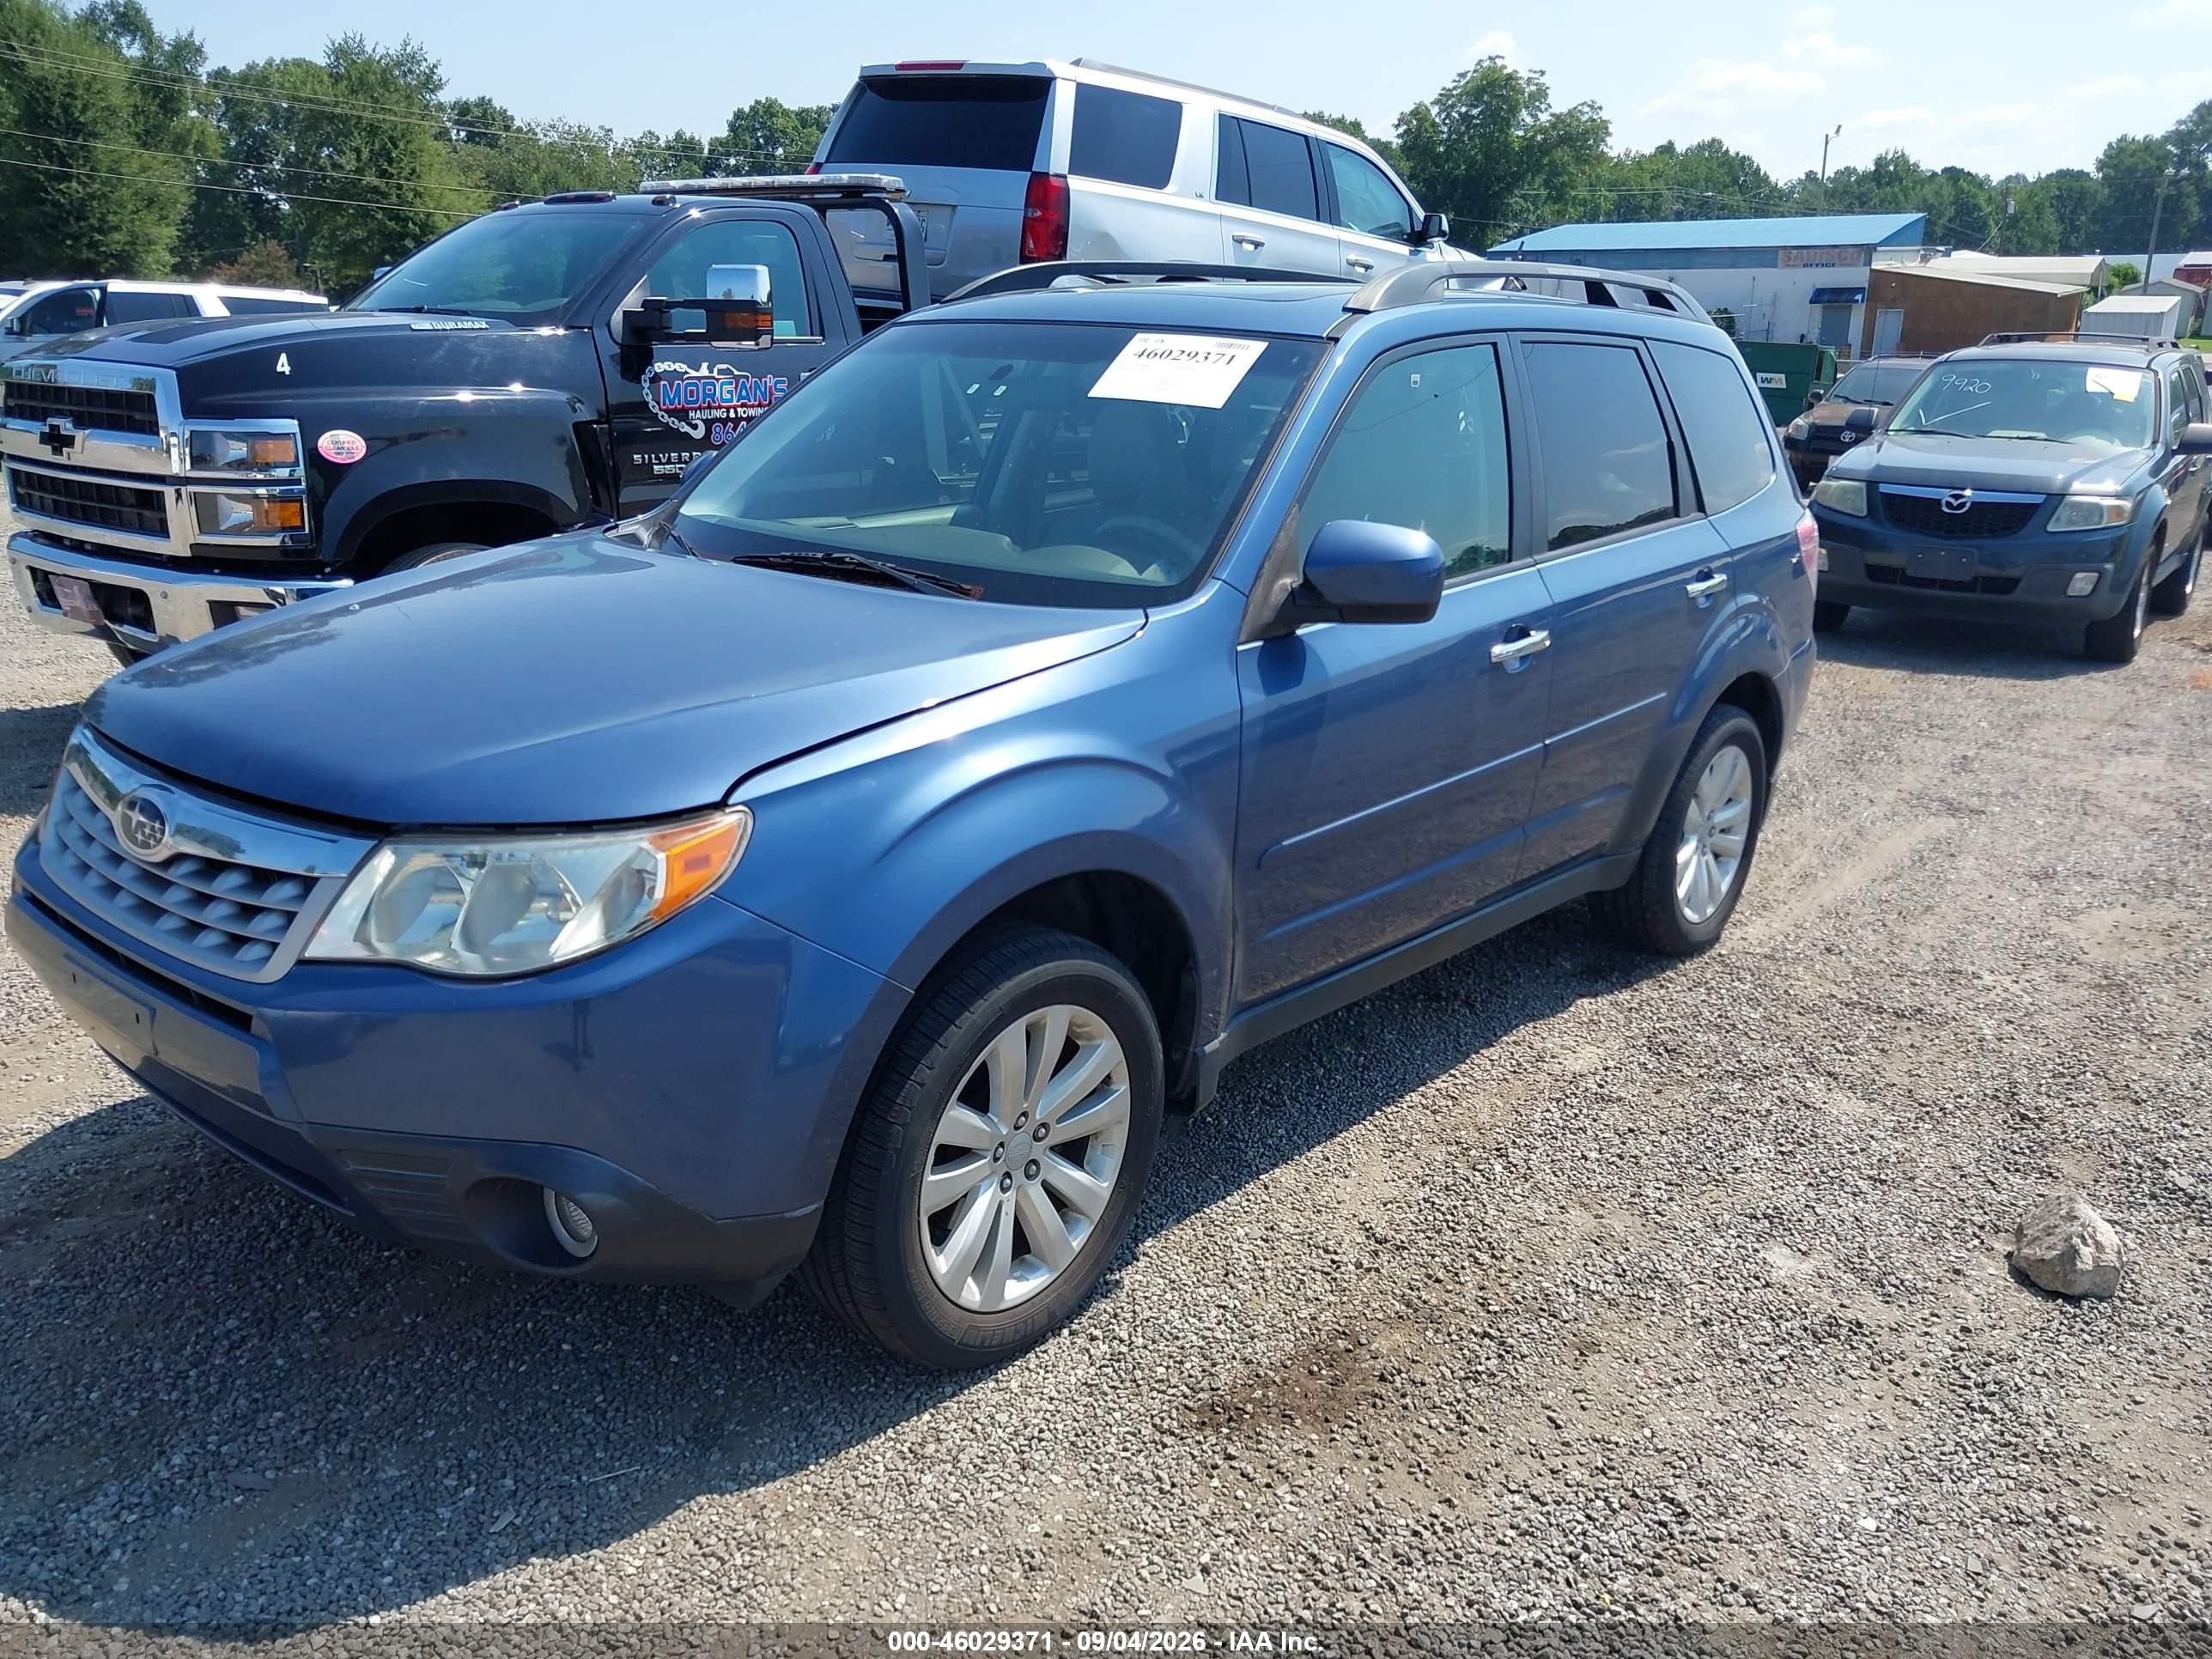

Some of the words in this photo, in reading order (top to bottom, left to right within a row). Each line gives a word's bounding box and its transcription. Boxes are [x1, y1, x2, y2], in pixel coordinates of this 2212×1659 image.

[432, 320, 489, 331] DURAMAX
[276, 353, 291, 375] 4
[1133, 347, 1237, 366] 46029371
[1760, 376, 1783, 386] WM
[1941, 373, 1991, 393] 9920
[659, 374, 788, 410] MORGAN'S
[689, 409, 726, 420] HAULING
[730, 409, 736, 418] &
